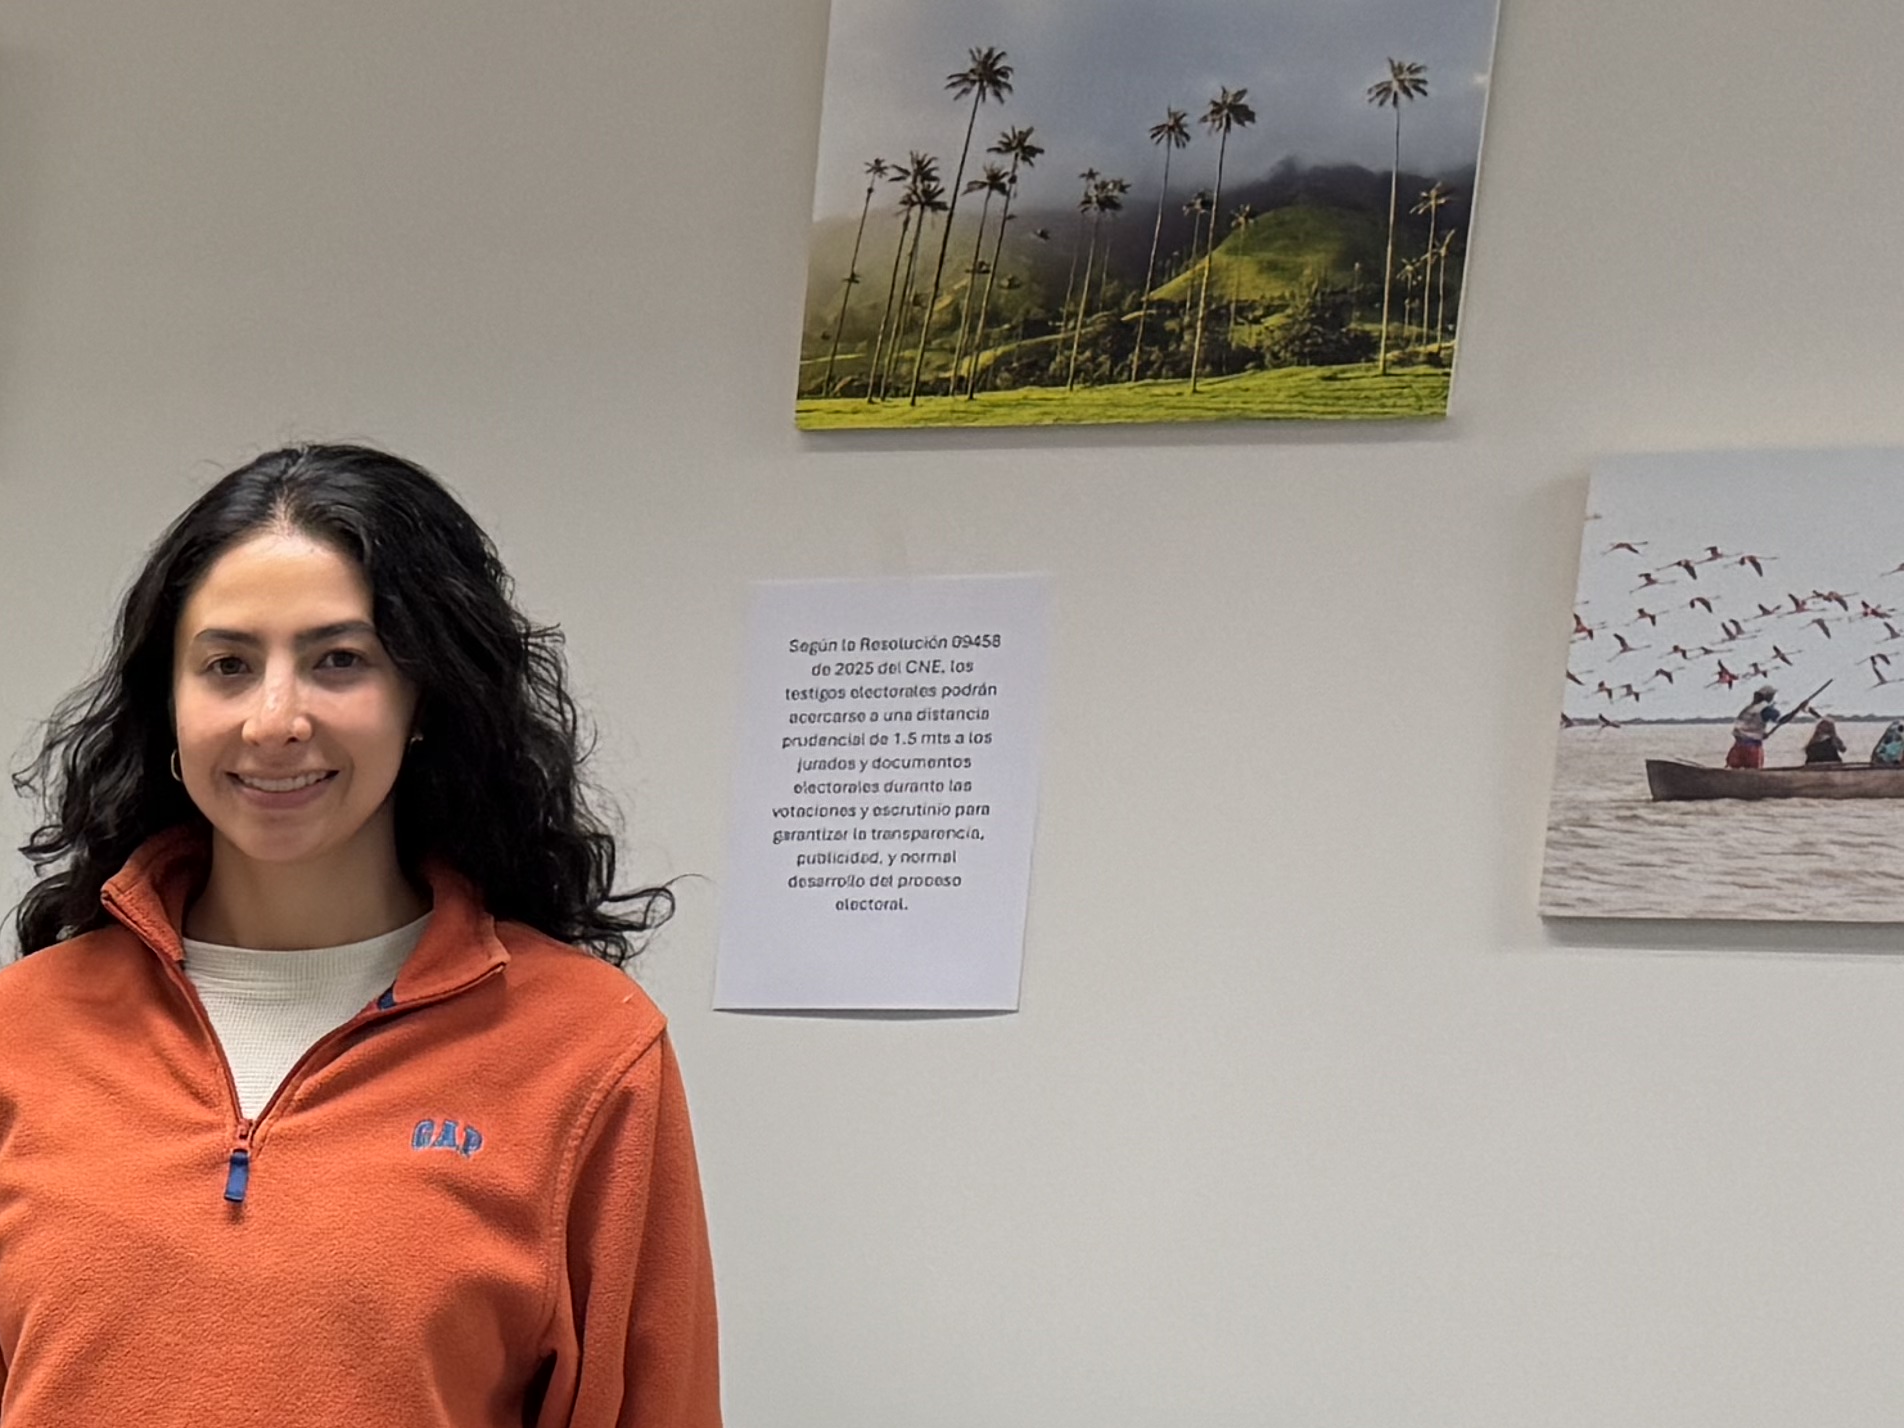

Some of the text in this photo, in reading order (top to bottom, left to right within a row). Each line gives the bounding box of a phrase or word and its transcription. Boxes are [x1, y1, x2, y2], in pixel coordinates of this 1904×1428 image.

[789, 639, 837, 655] Según
[860, 638, 947, 651] Resolución
[812, 664, 830, 676] de
[835, 662, 874, 675] 2025
[878, 661, 901, 674] del
[950, 660, 974, 672] los
[786, 683, 997, 702] testigos electorales podrán
[789, 708, 990, 724] acercarse a una distancia
[782, 731, 992, 748] prudencial de 1.5 mts a los
[797, 757, 971, 773] jurados y documentos
[794, 779, 972, 794] electorales durante las
[772, 803, 990, 819] votaciones y escrutinio para
[772, 828, 848, 845] garantizar
[853, 828, 866, 839] la
[888, 853, 897, 866] y
[900, 851, 956, 864] normal
[788, 875, 961, 888] desarrollo del proceso
[836, 898, 908, 911] electoral.
